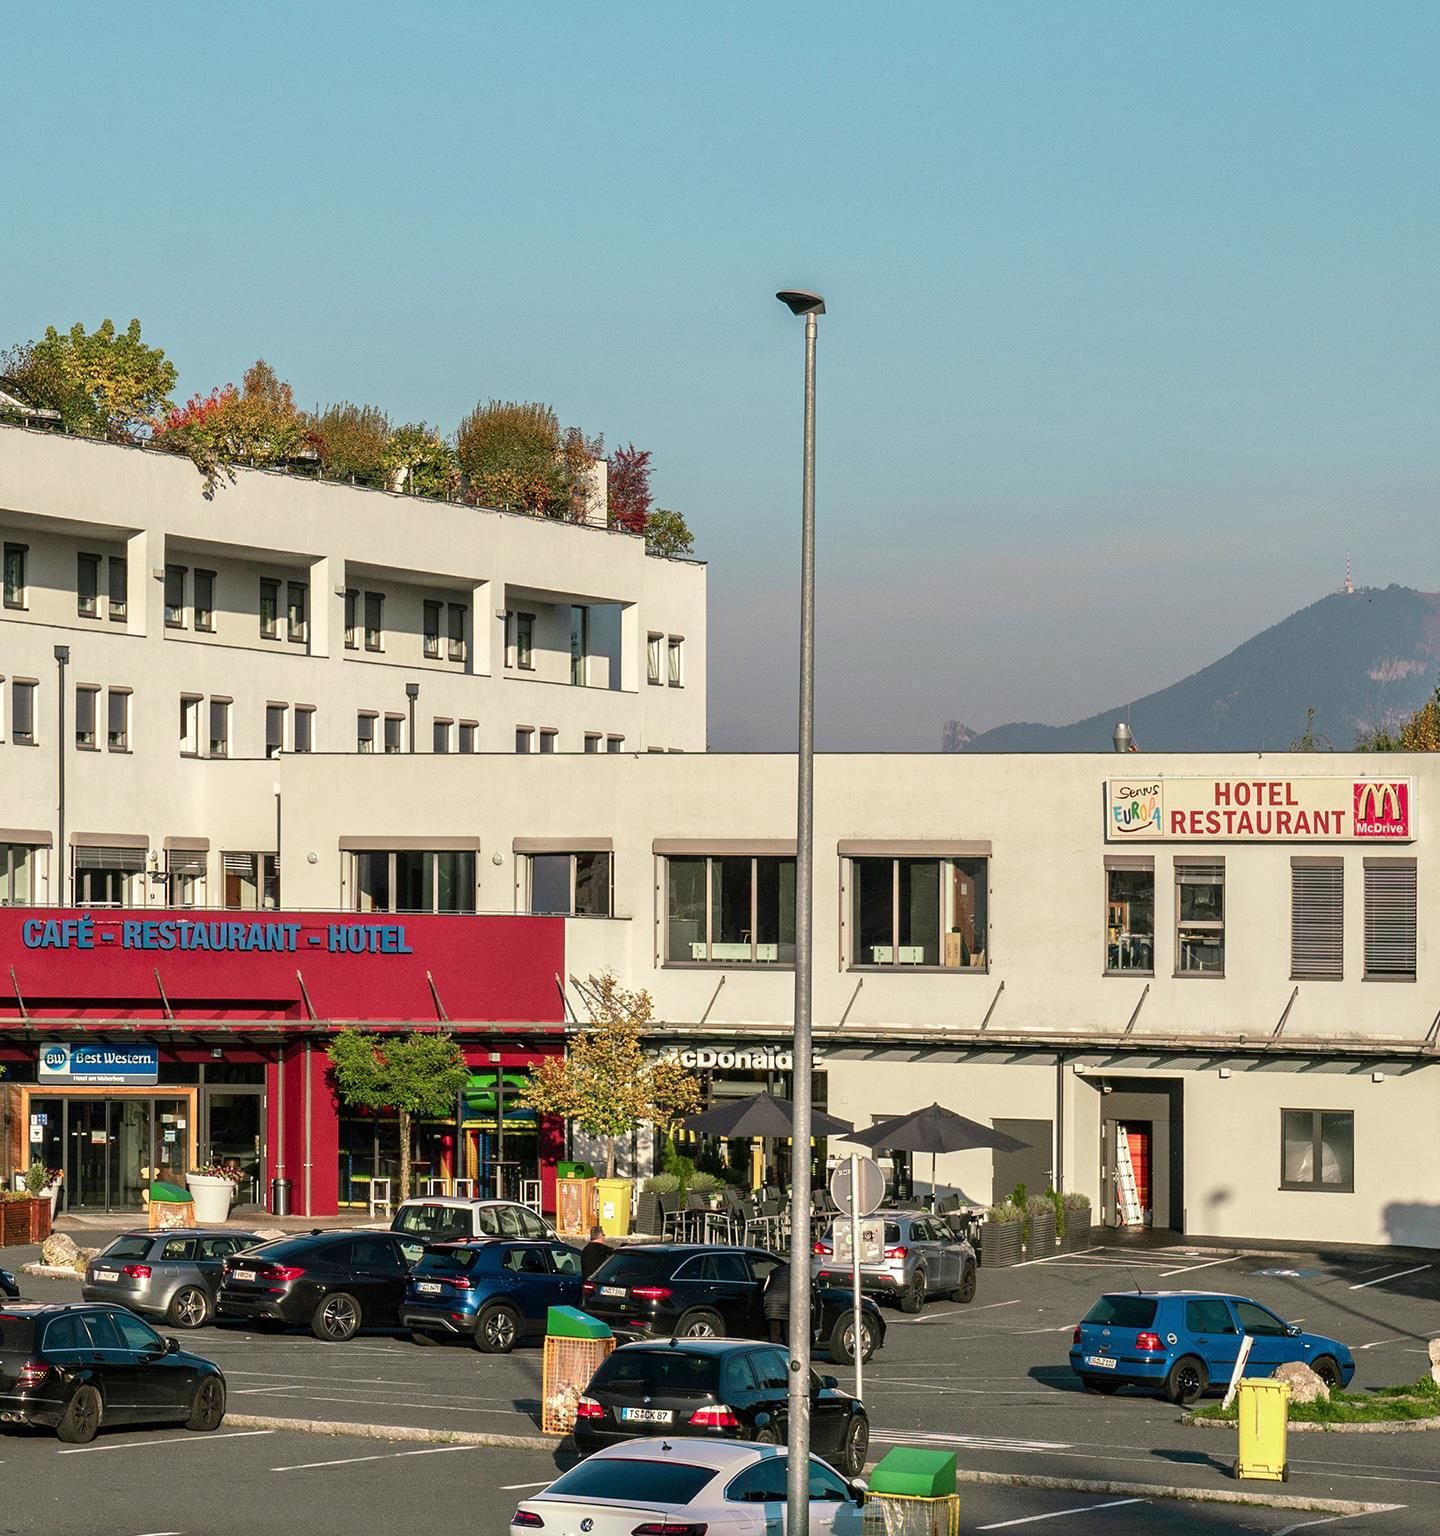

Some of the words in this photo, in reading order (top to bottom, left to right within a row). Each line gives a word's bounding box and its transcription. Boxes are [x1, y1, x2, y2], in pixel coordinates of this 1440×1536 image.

[1115, 784, 1161, 800] Servus
[1214, 782, 1299, 806] HOTEL
[1113, 796, 1162, 831] EUROPA
[1170, 810, 1346, 834] RESTAURANT
[1356, 822, 1404, 834] McDrive
[23, 914, 95, 949] CAFÉ
[122, 920, 301, 952] RESTAURANT
[329, 925, 413, 953] HOTEL
[46, 1054, 65, 1065] BW
[75, 1052, 102, 1064] Best
[629, 1410, 640, 1419] TS
[657, 1411, 668, 1420] 87
